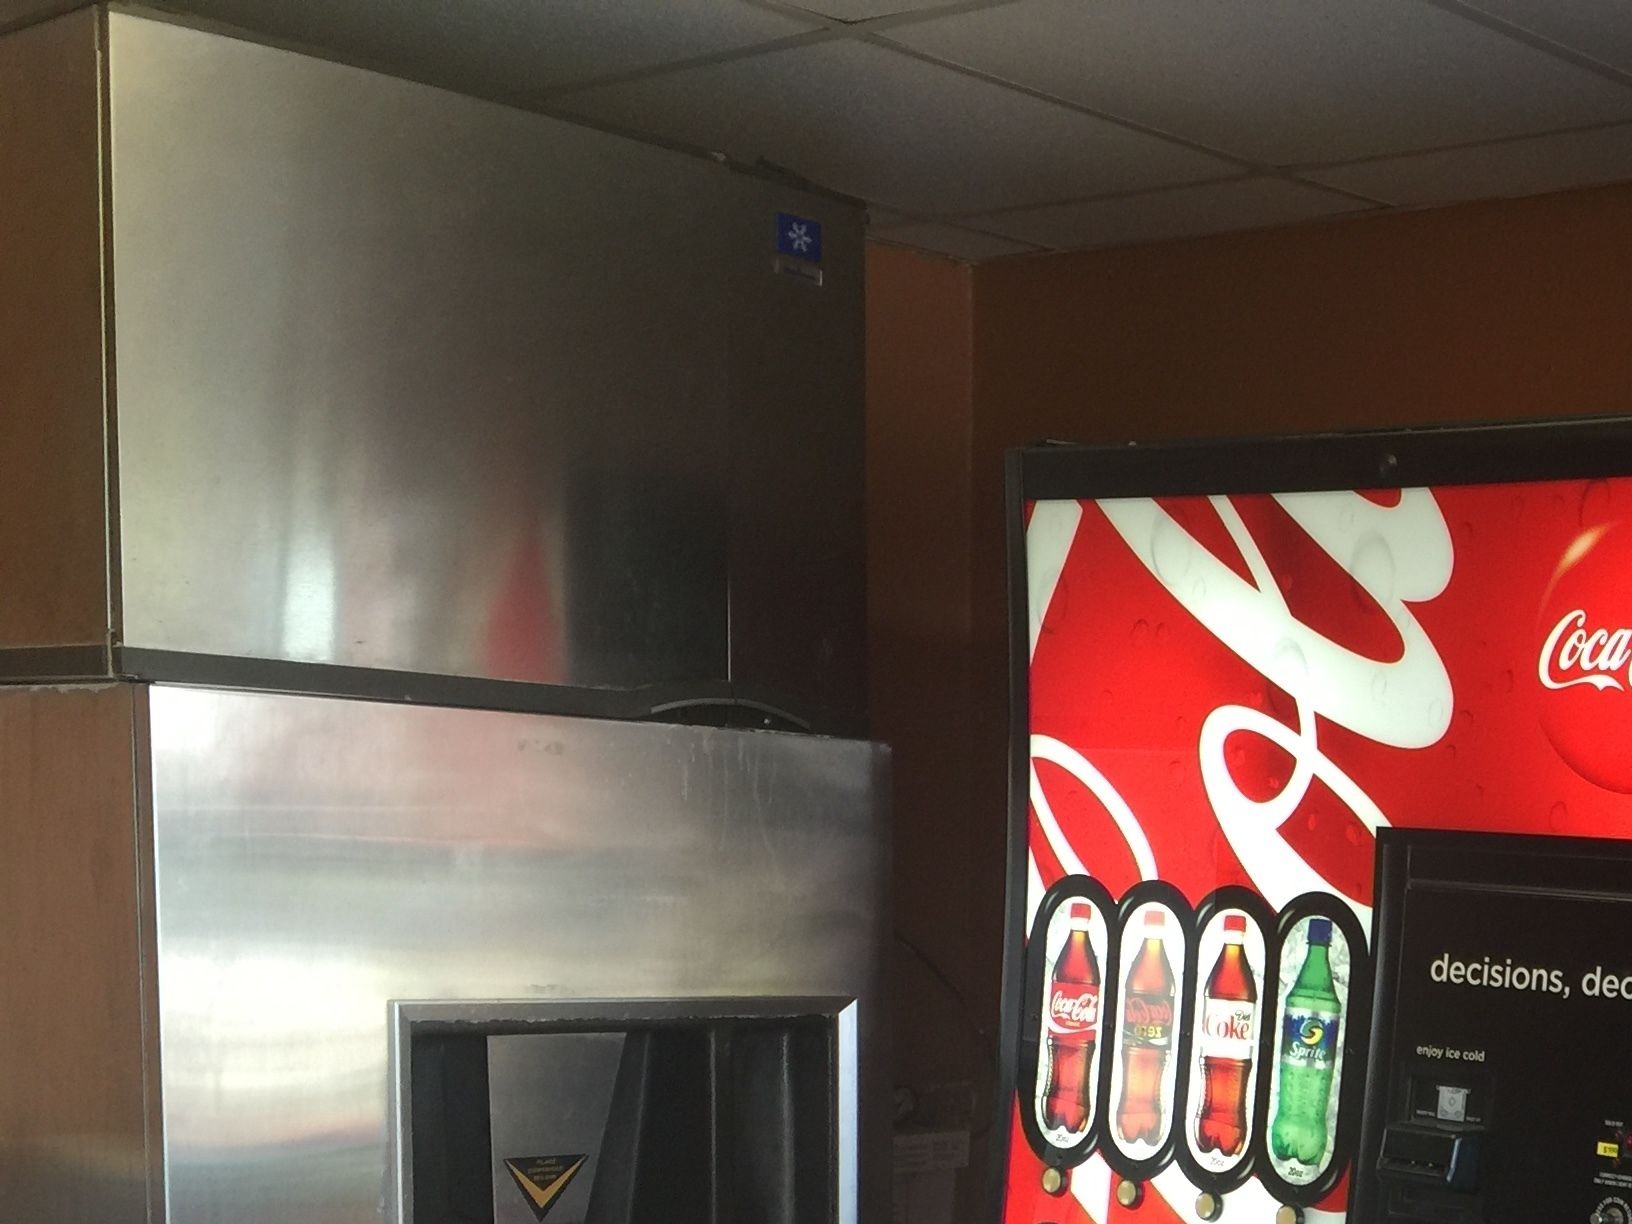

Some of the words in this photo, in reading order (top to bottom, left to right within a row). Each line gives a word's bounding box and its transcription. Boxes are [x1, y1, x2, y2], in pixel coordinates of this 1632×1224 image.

[1429, 955, 1572, 1000] decisions,
[1204, 1014, 1250, 1040] Coke
[1288, 1041, 1327, 1062] Sprite
[1415, 1044, 1444, 1060] enjoy
[1445, 1046, 1461, 1060] ice
[1462, 1050, 1486, 1063] cold
